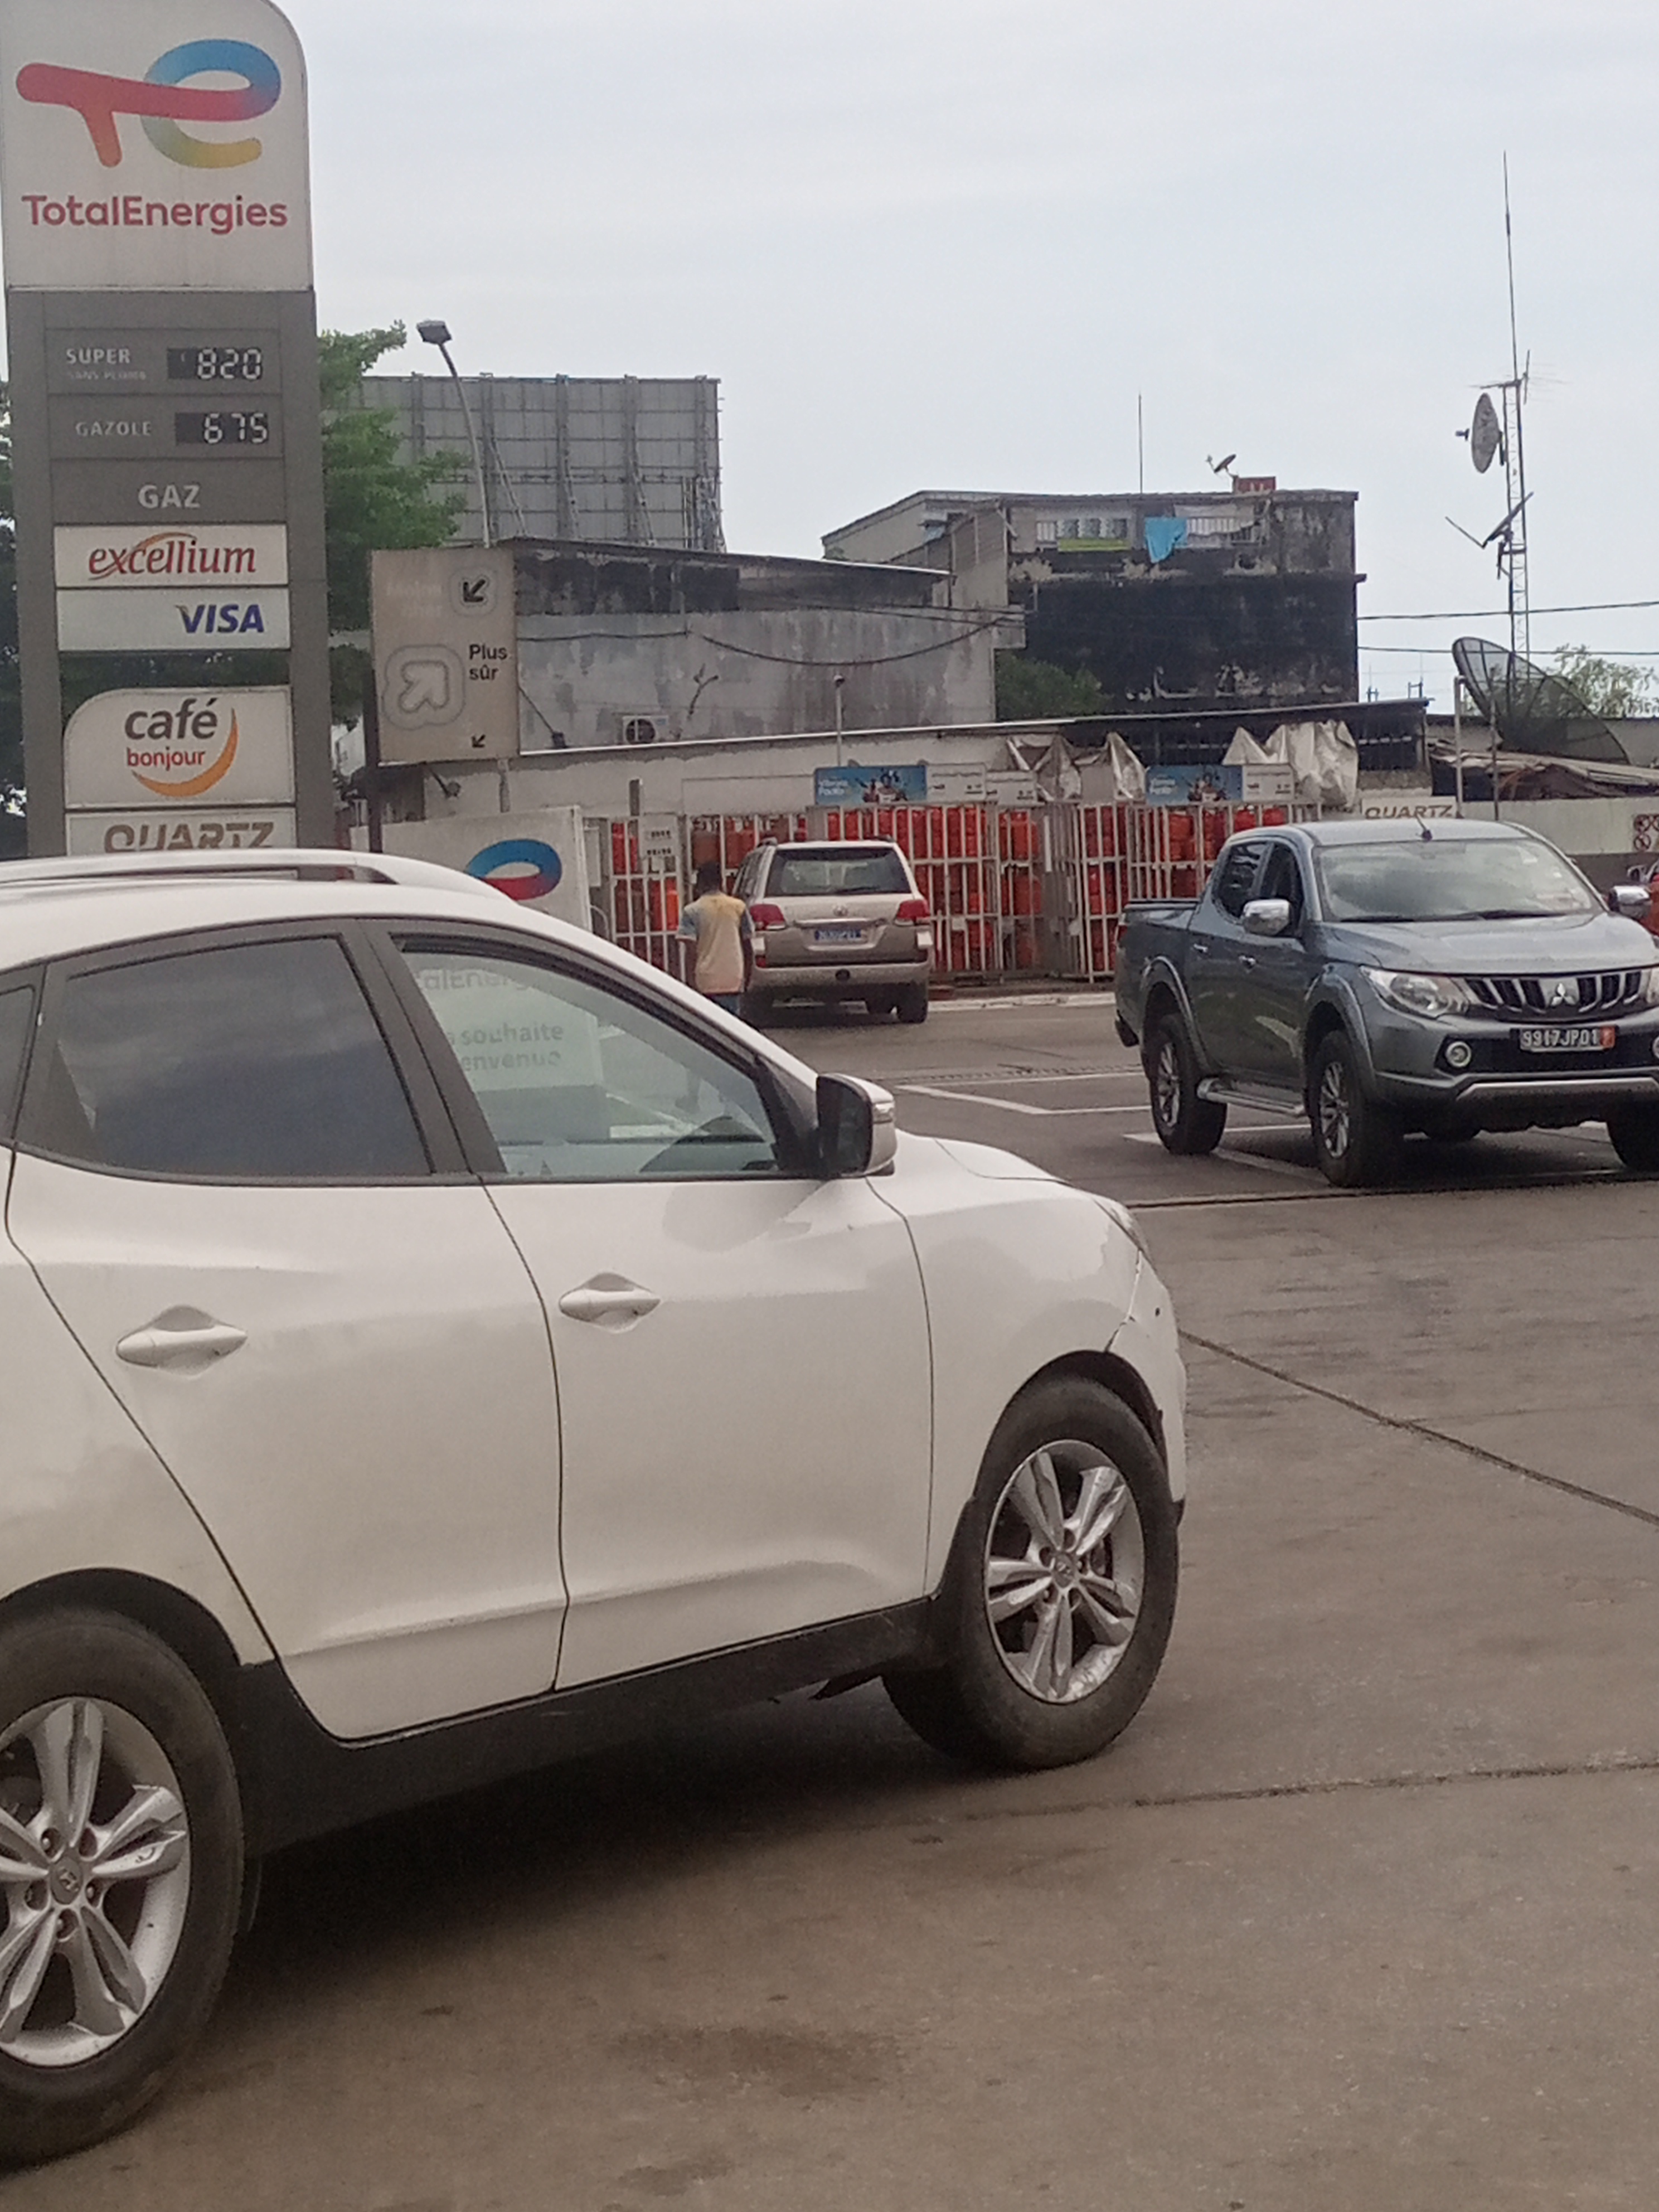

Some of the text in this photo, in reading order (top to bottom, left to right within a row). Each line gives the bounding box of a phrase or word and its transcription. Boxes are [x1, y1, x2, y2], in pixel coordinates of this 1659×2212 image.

[21, 195, 288, 235] TotalEnergies
[66, 348, 262, 380] SUPER 820
[75, 413, 268, 444] GAZOLE 675
[138, 484, 201, 509] GAZ
[89, 540, 256, 575] excellium
[176, 604, 265, 634] VISA
[469, 643, 508, 660] Plus
[469, 663, 499, 681] sûr
[124, 698, 219, 740] café
[127, 747, 206, 771] bonjour
[1365, 804, 1453, 819] QUARTZ
[104, 821, 275, 854] QUARTZ
[460, 1022, 564, 1046] souhaite
[460, 1050, 562, 1071] envenue
